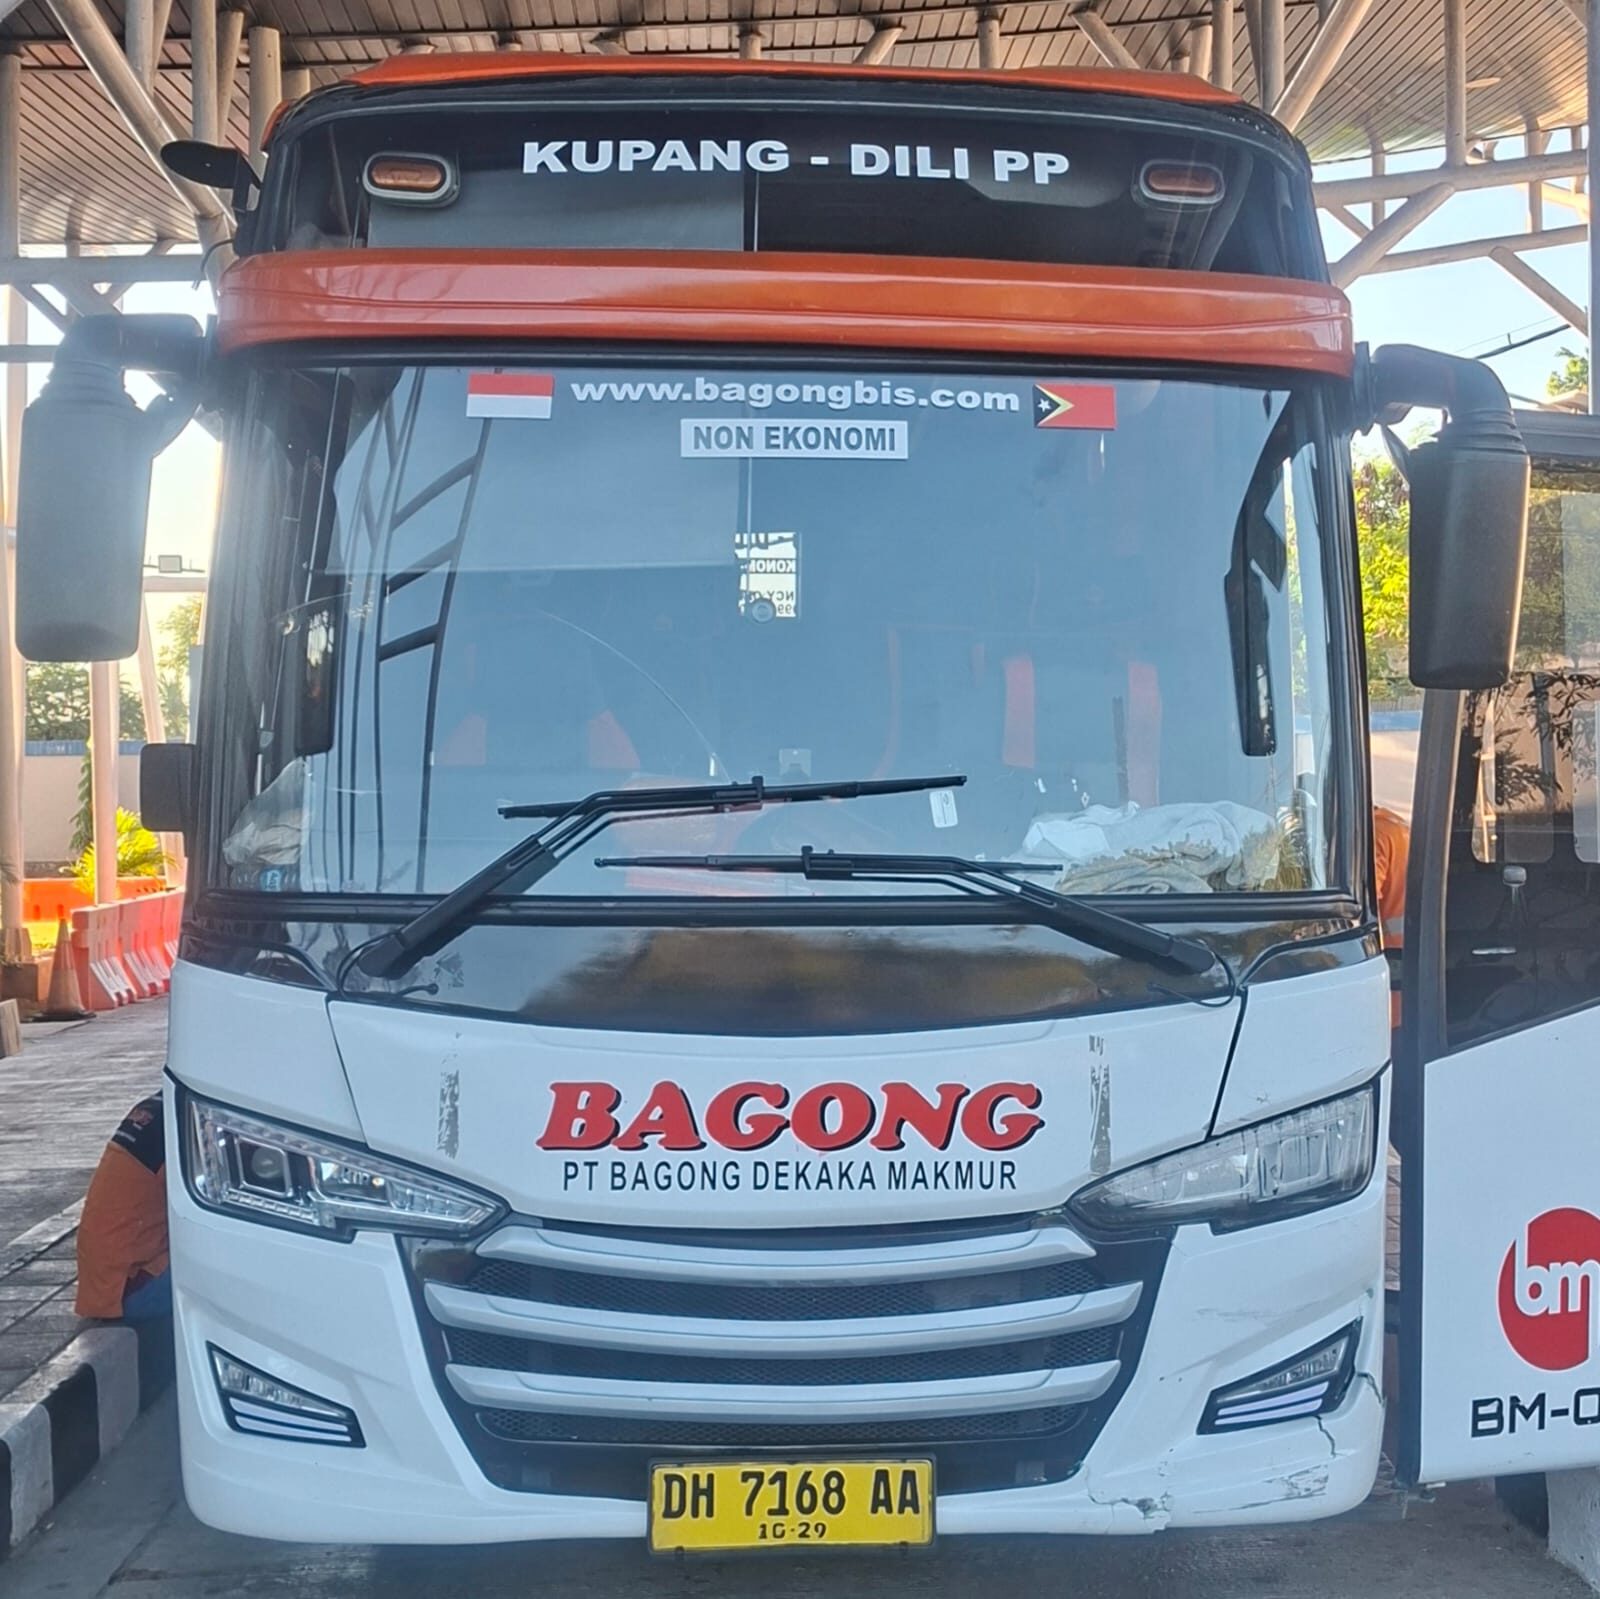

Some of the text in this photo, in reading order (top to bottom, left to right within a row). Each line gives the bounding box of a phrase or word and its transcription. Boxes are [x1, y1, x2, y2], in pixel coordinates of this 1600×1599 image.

[522, 139, 1070, 185] KUPANG - DILI PP
[570, 376, 1021, 412] www.bagongbis.com
[692, 425, 897, 452] NON EKONOMI
[536, 1080, 1046, 1152] BAGONG
[563, 1161, 1017, 1191] PT BAGONG DEKAKA MAKMUR
[662, 1469, 920, 1518] DH 7168 AA
